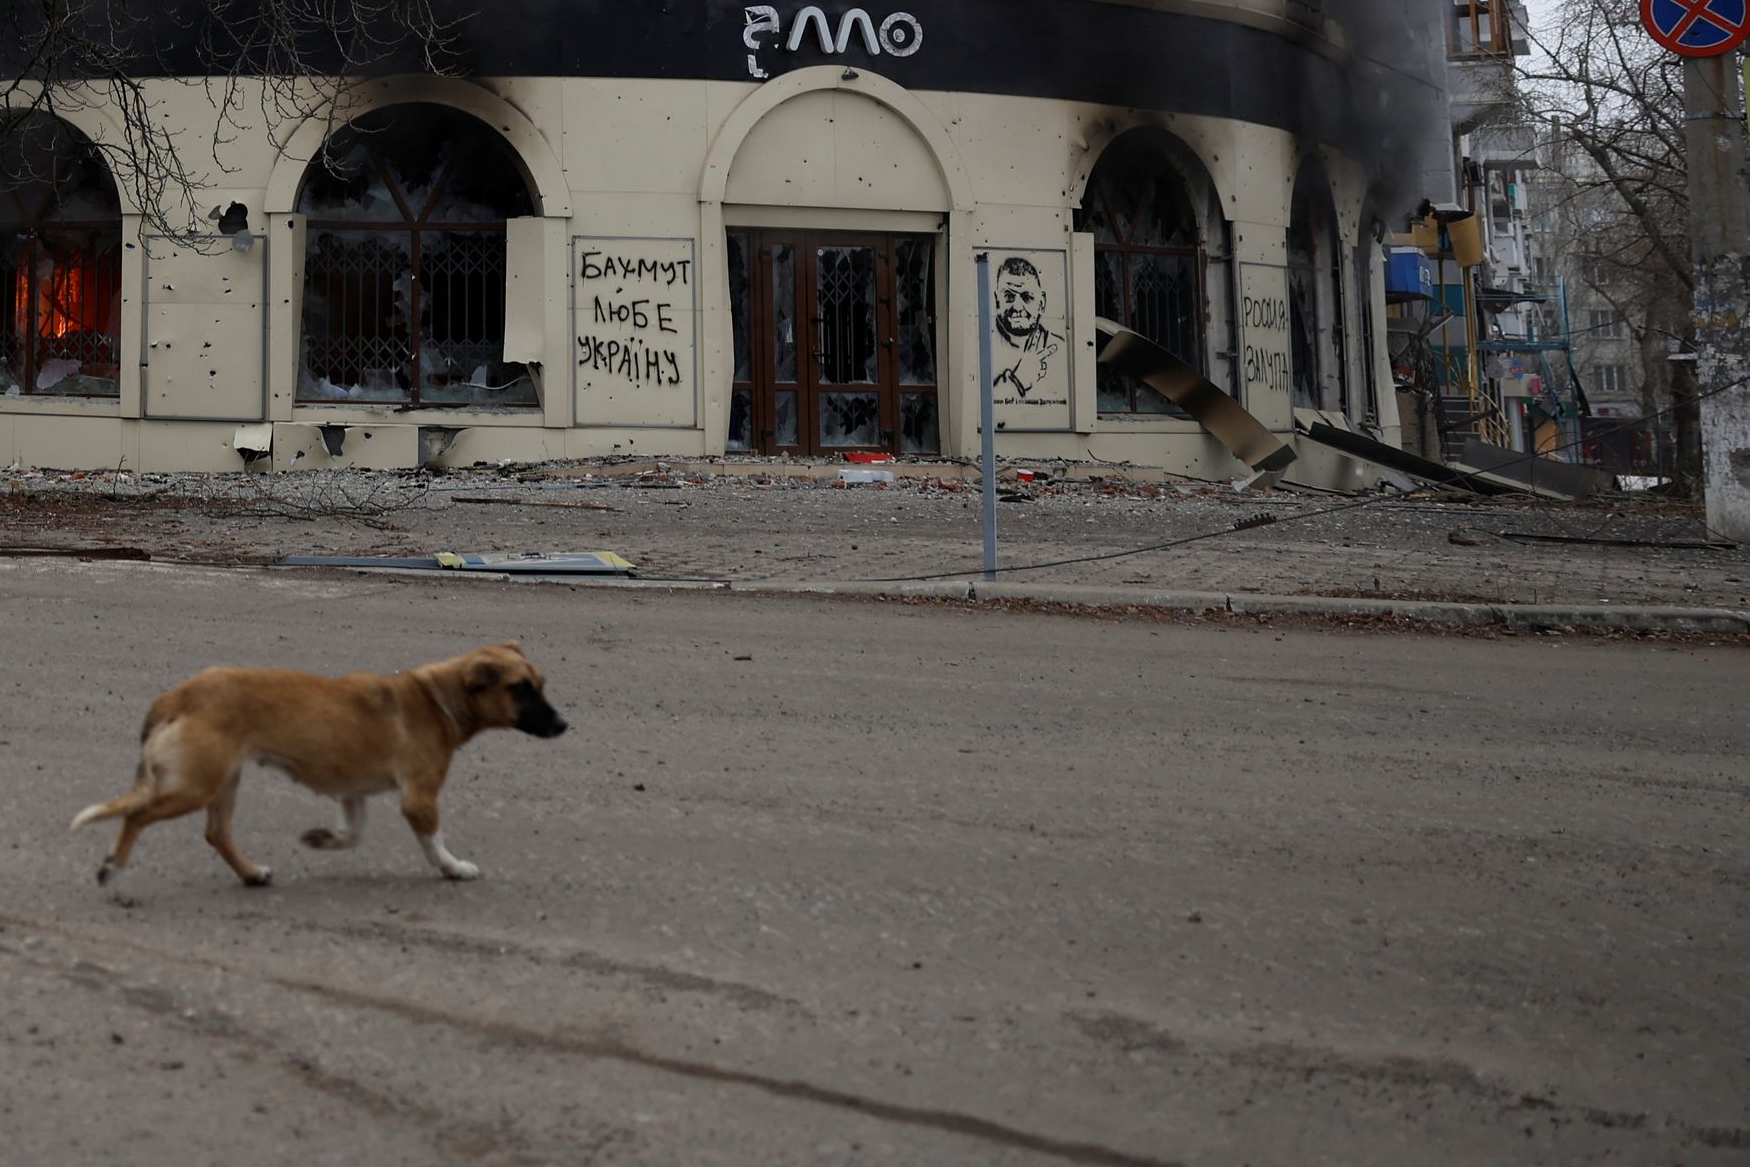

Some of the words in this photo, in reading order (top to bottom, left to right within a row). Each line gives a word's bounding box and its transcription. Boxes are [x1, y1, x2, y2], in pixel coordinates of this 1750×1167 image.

[581, 251, 691, 287] БАХМУТ
[594, 295, 678, 333] ЛЮБЕ
[577, 335, 681, 386] УКРАЇНУ
[1246, 345, 1289, 393] ЗАЛУПА
